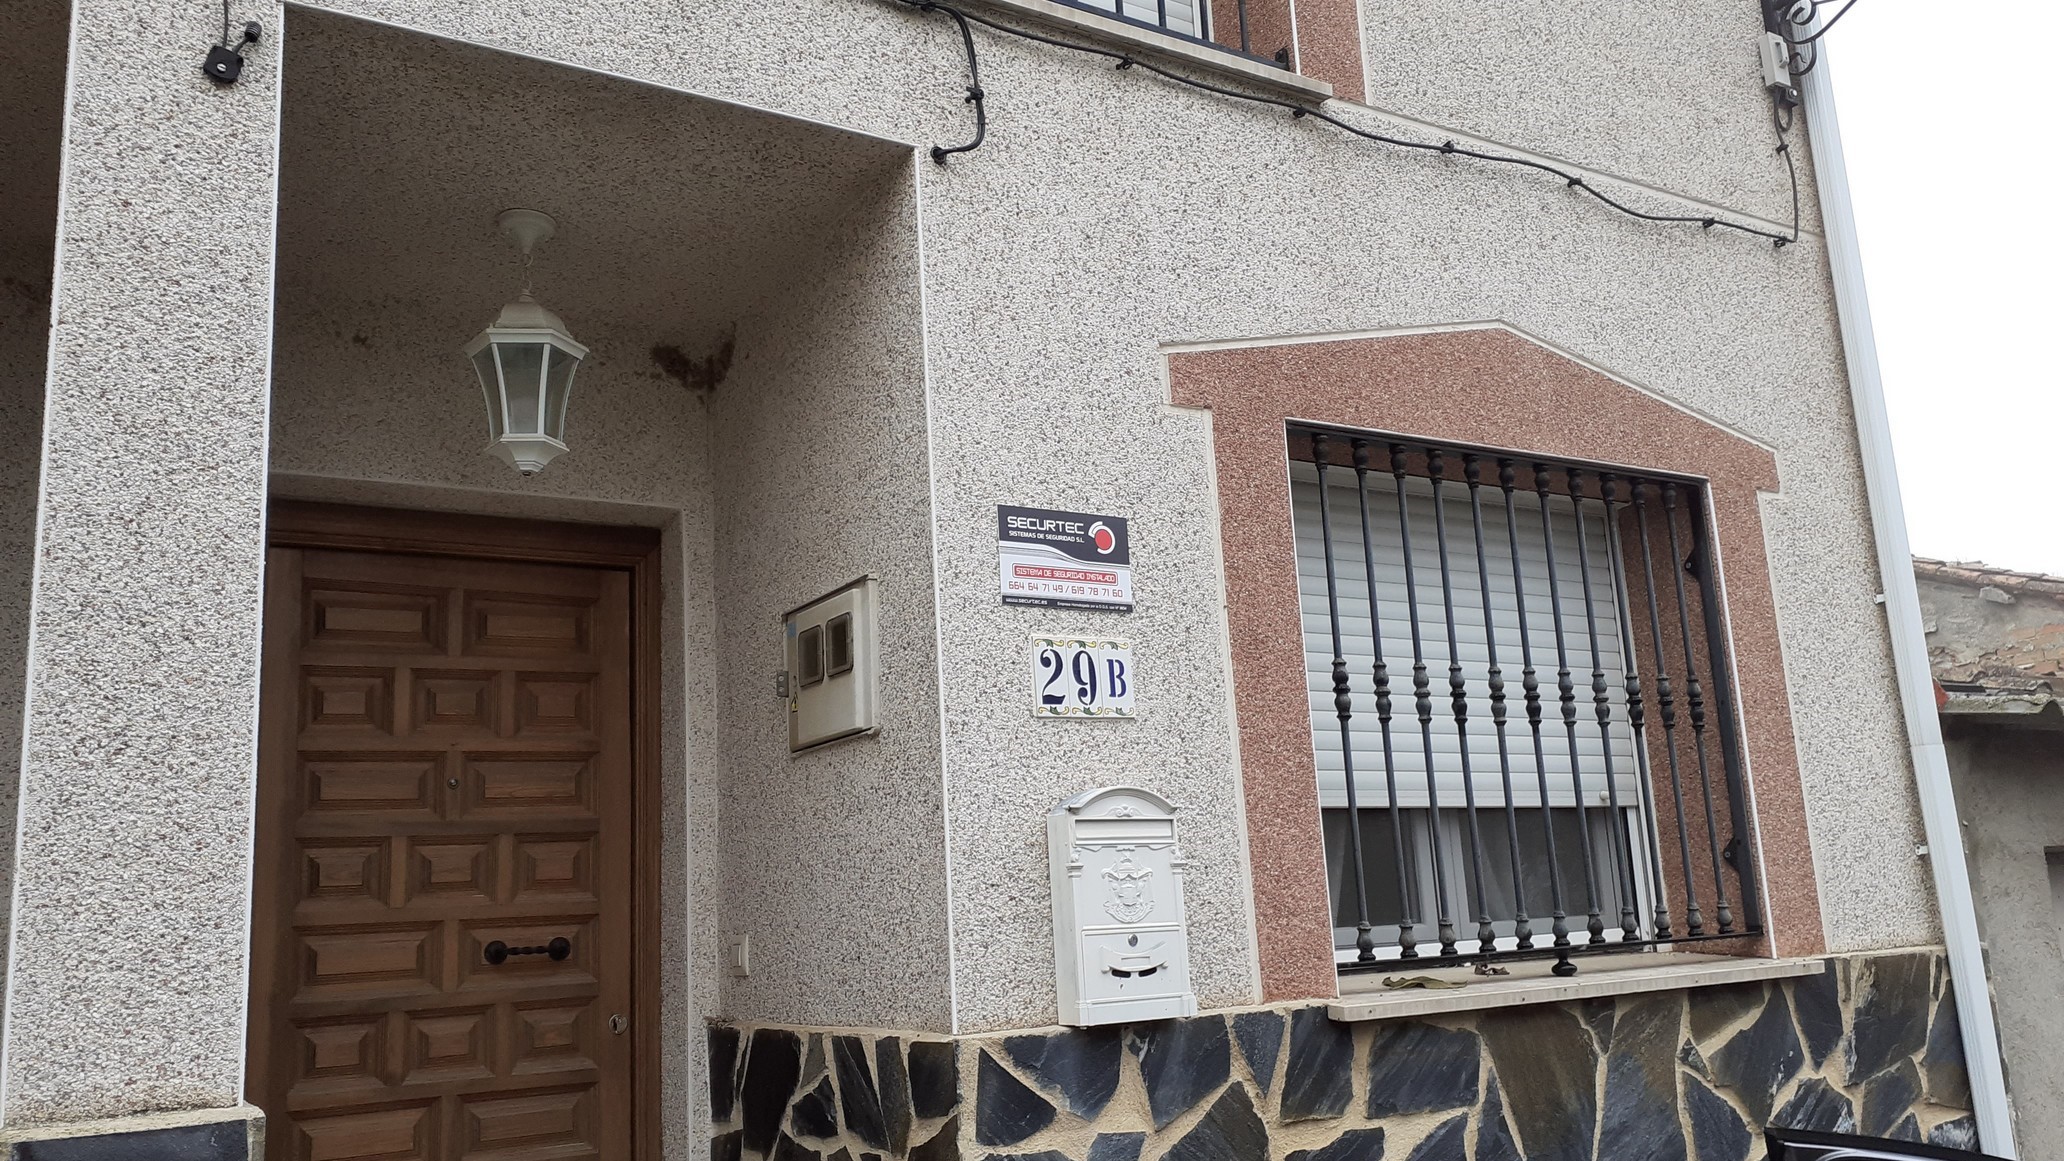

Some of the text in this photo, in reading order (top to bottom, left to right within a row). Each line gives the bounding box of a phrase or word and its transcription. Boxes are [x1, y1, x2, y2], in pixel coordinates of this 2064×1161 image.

[1007, 516, 1084, 534] SECURTEC
[1036, 532, 1045, 540] DE
[1045, 534, 1075, 542] SEGURIDAD
[1016, 568, 1115, 582] SISTEMA DE SEGURIDAD INSTALADO
[1009, 581, 1025, 590] 664
[1027, 582, 1039, 592] 64
[1041, 583, 1050, 593] 71
[1052, 584, 1064, 594] 49
[1071, 586, 1085, 595] 619
[1088, 587, 1099, 596] 78
[1101, 588, 1110, 597] 71
[1112, 589, 1123, 597] 60
